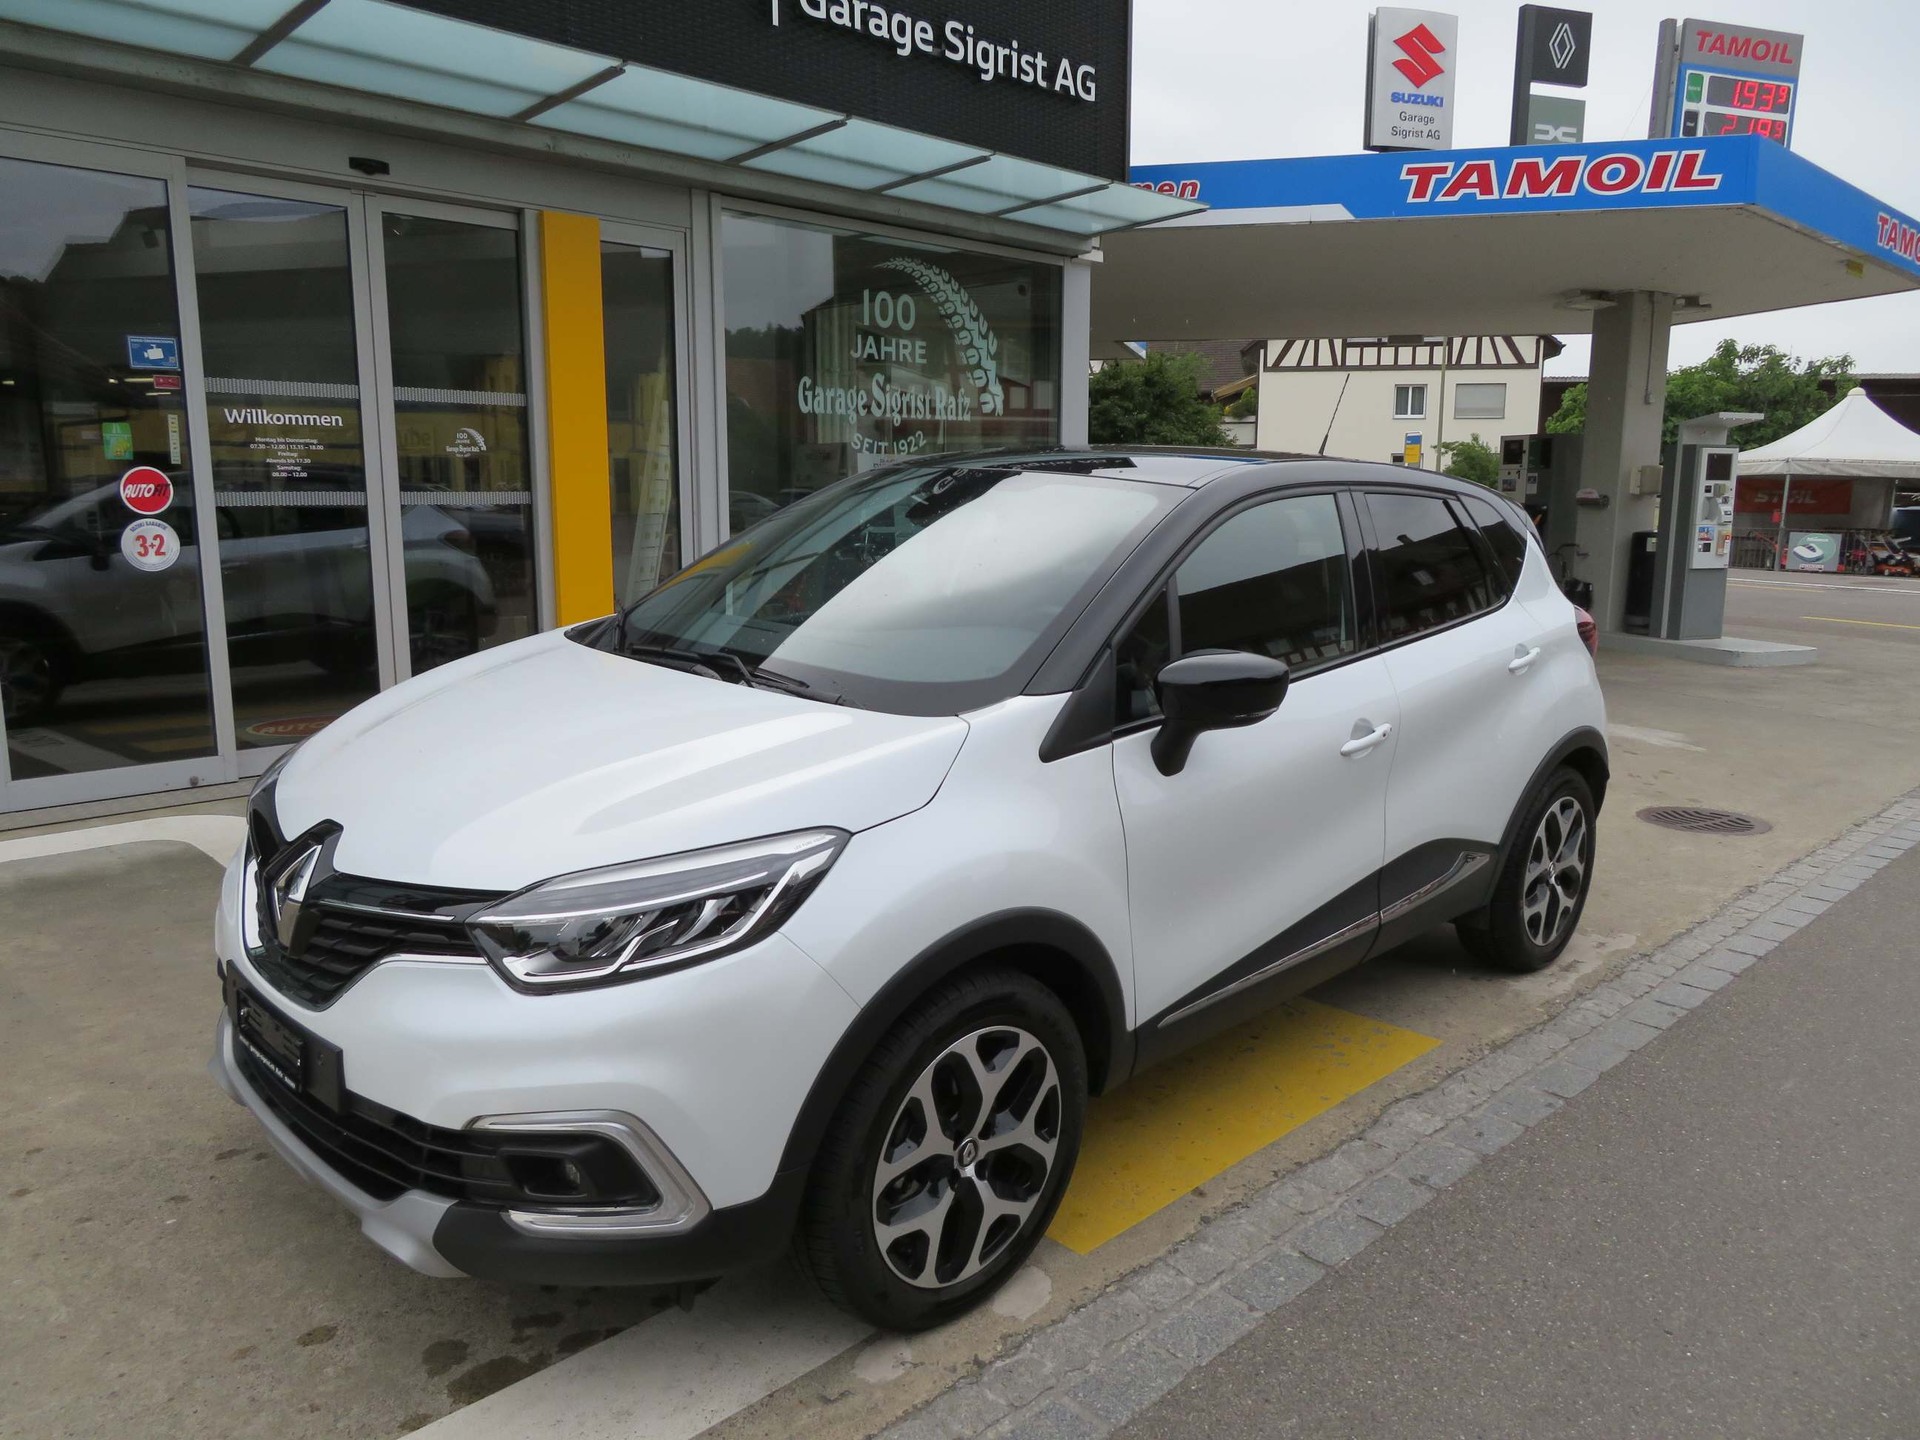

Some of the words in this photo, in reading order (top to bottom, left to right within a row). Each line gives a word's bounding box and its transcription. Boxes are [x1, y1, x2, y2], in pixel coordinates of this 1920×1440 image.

[944, 20, 1048, 88] Sigrist
[1054, 57, 1096, 102] AG
[1696, 30, 1794, 64] TAMOIL
[1390, 91, 1444, 108] SUZUKI
[1399, 110, 1435, 126] Garage
[1390, 125, 1424, 140] Sigrist
[1426, 129, 1441, 140] AG
[1400, 150, 1723, 204] TAMOIL
[863, 288, 916, 331] 100
[851, 334, 928, 365] JAHRE
[798, 375, 868, 425] Garage
[870, 372, 932, 427] Sigrist
[934, 386, 972, 422] Rafz
[223, 408, 344, 427] Willkommen
[851, 432, 889, 456] SEIT
[892, 430, 927, 456] 1922
[135, 533, 167, 557] 3+2
